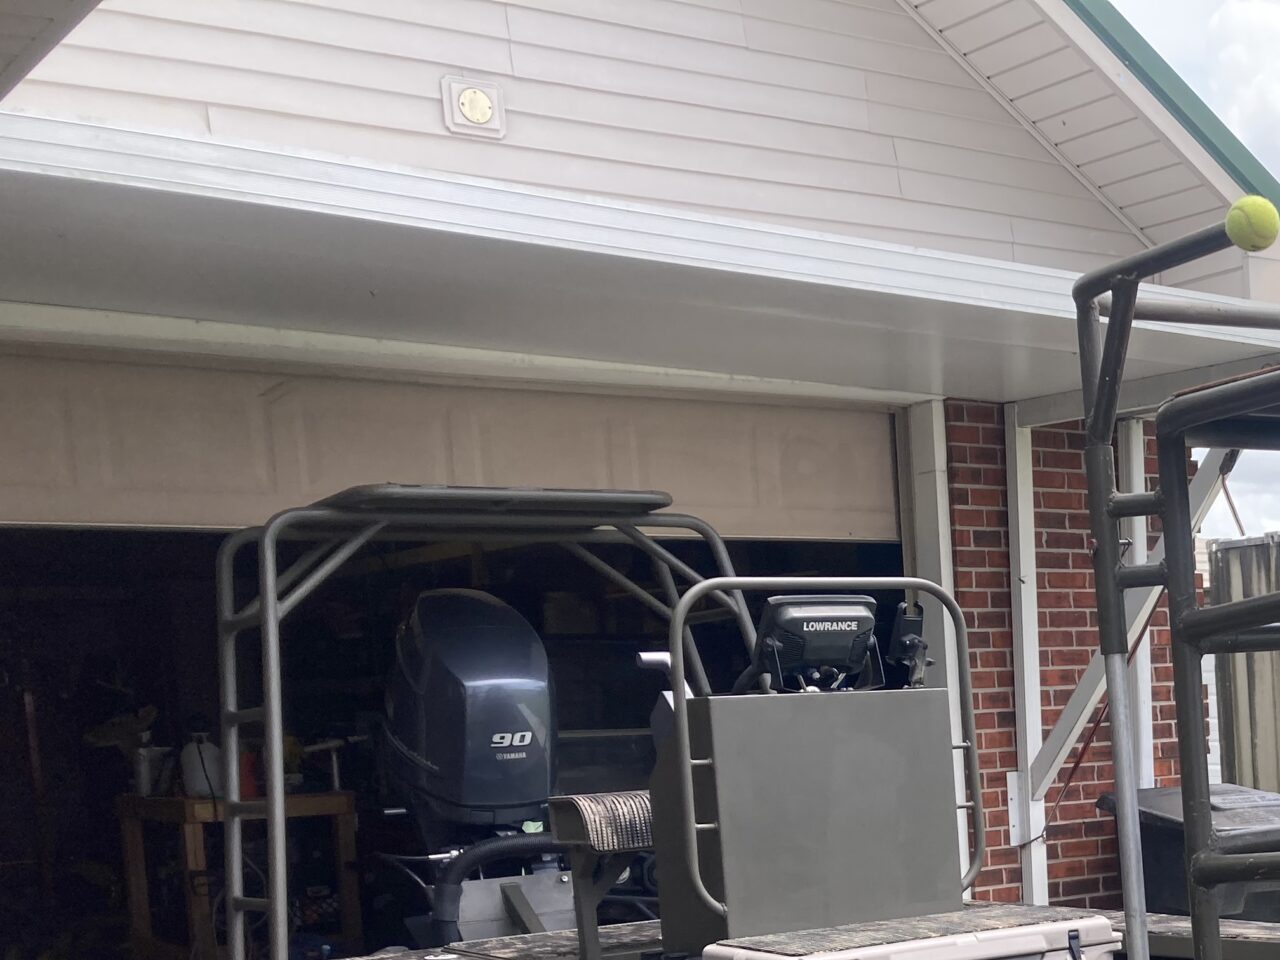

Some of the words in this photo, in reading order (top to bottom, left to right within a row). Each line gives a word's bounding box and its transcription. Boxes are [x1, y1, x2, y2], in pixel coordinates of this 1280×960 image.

[803, 621, 858, 631] LOWRANCE
[490, 731, 532, 747] 90
[503, 752, 527, 760] YAMAHA
